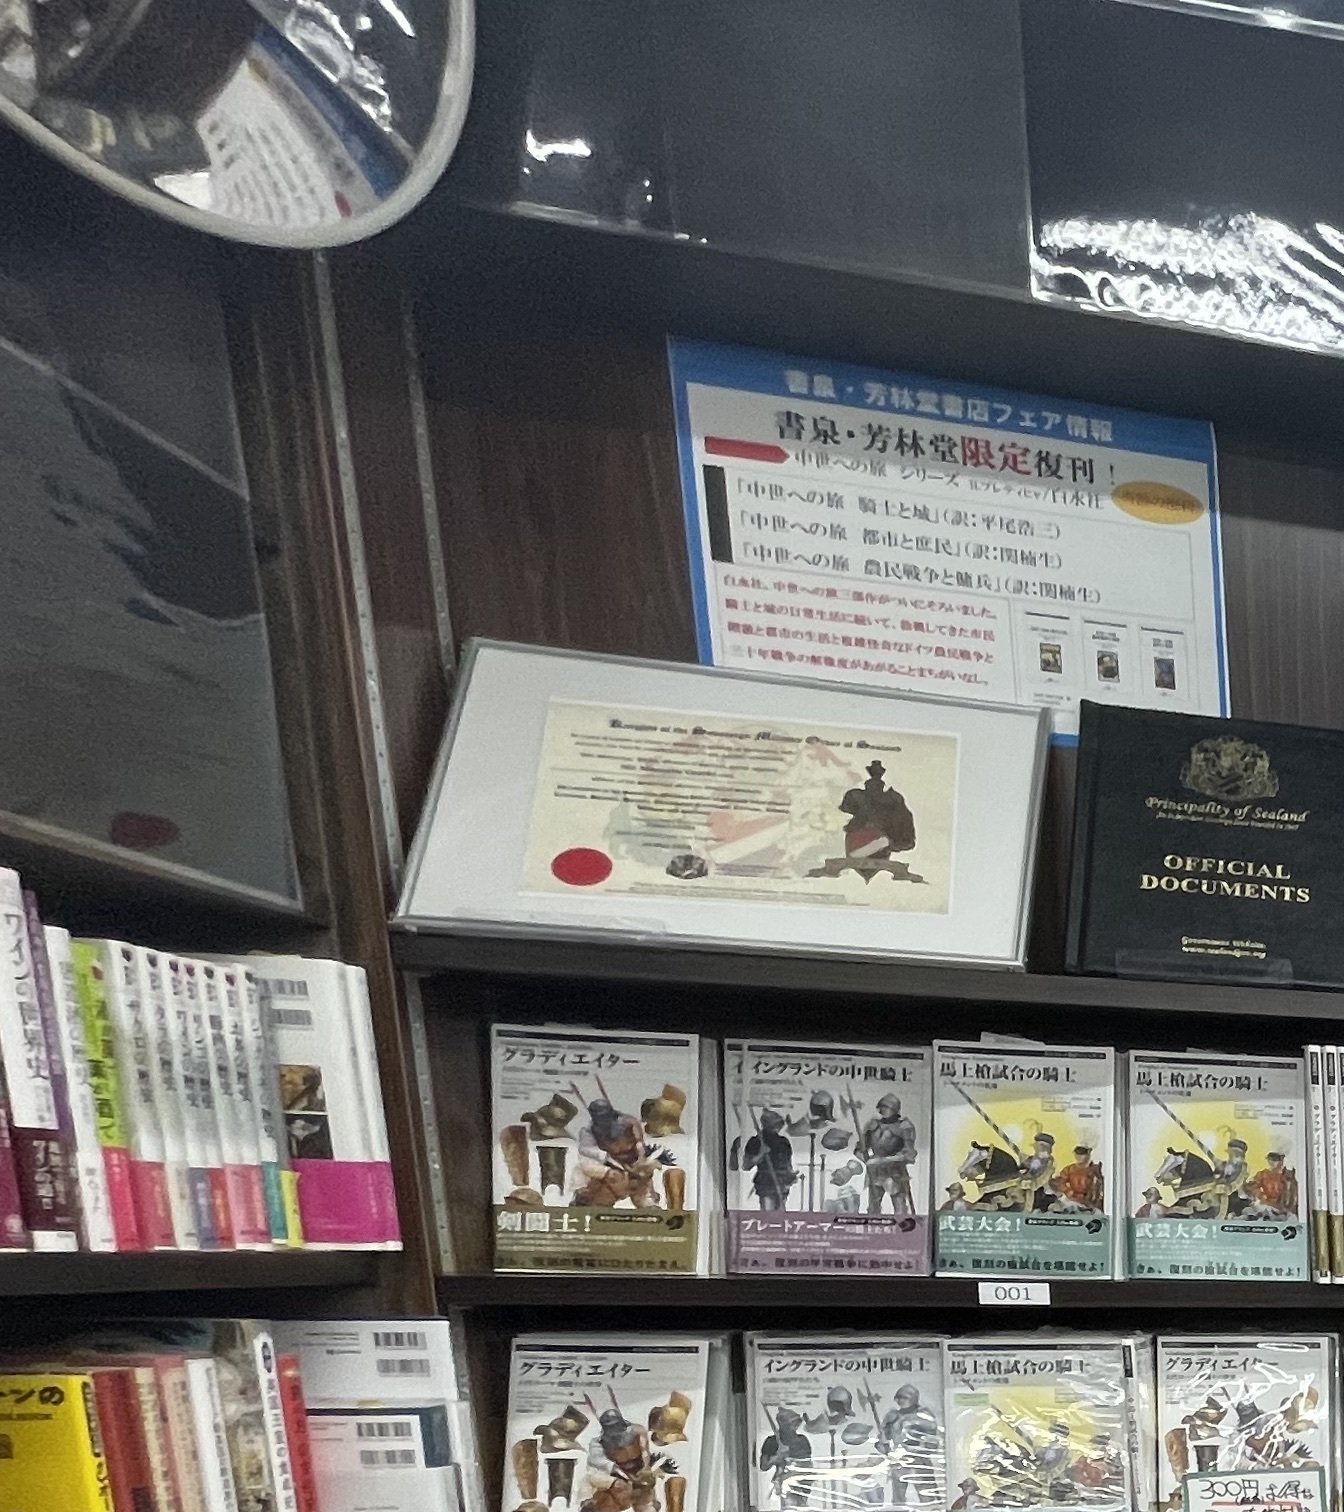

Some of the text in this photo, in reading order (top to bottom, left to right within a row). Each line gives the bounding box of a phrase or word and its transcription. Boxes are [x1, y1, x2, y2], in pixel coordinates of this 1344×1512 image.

[774, 409, 1118, 486] 書泉・芳林堂限定復刊！
[792, 446, 961, 490] 中世への旅 シリーズ
[1146, 796, 1230, 820] Principality
[1231, 803, 1251, 822] of
[1252, 805, 1309, 824] Sealand
[1162, 852, 1292, 881] OFFICIAL
[1138, 872, 1312, 904] DOCUMENTS
[501, 1046, 641, 1067] グラディエイター
[752, 1060, 913, 1083] イングランドの中世騎士
[940, 1060, 1076, 1084] 馬上槍試合の騎士
[1136, 1070, 1268, 1092] 馬上槍試合の騎士
[994, 1286, 1032, 1302] 001
[519, 1361, 651, 1378] グラディエイター
[762, 1357, 930, 1373] イングランドの中世騎士
[951, 1358, 1091, 1376] 馬上槍試合の騎士
